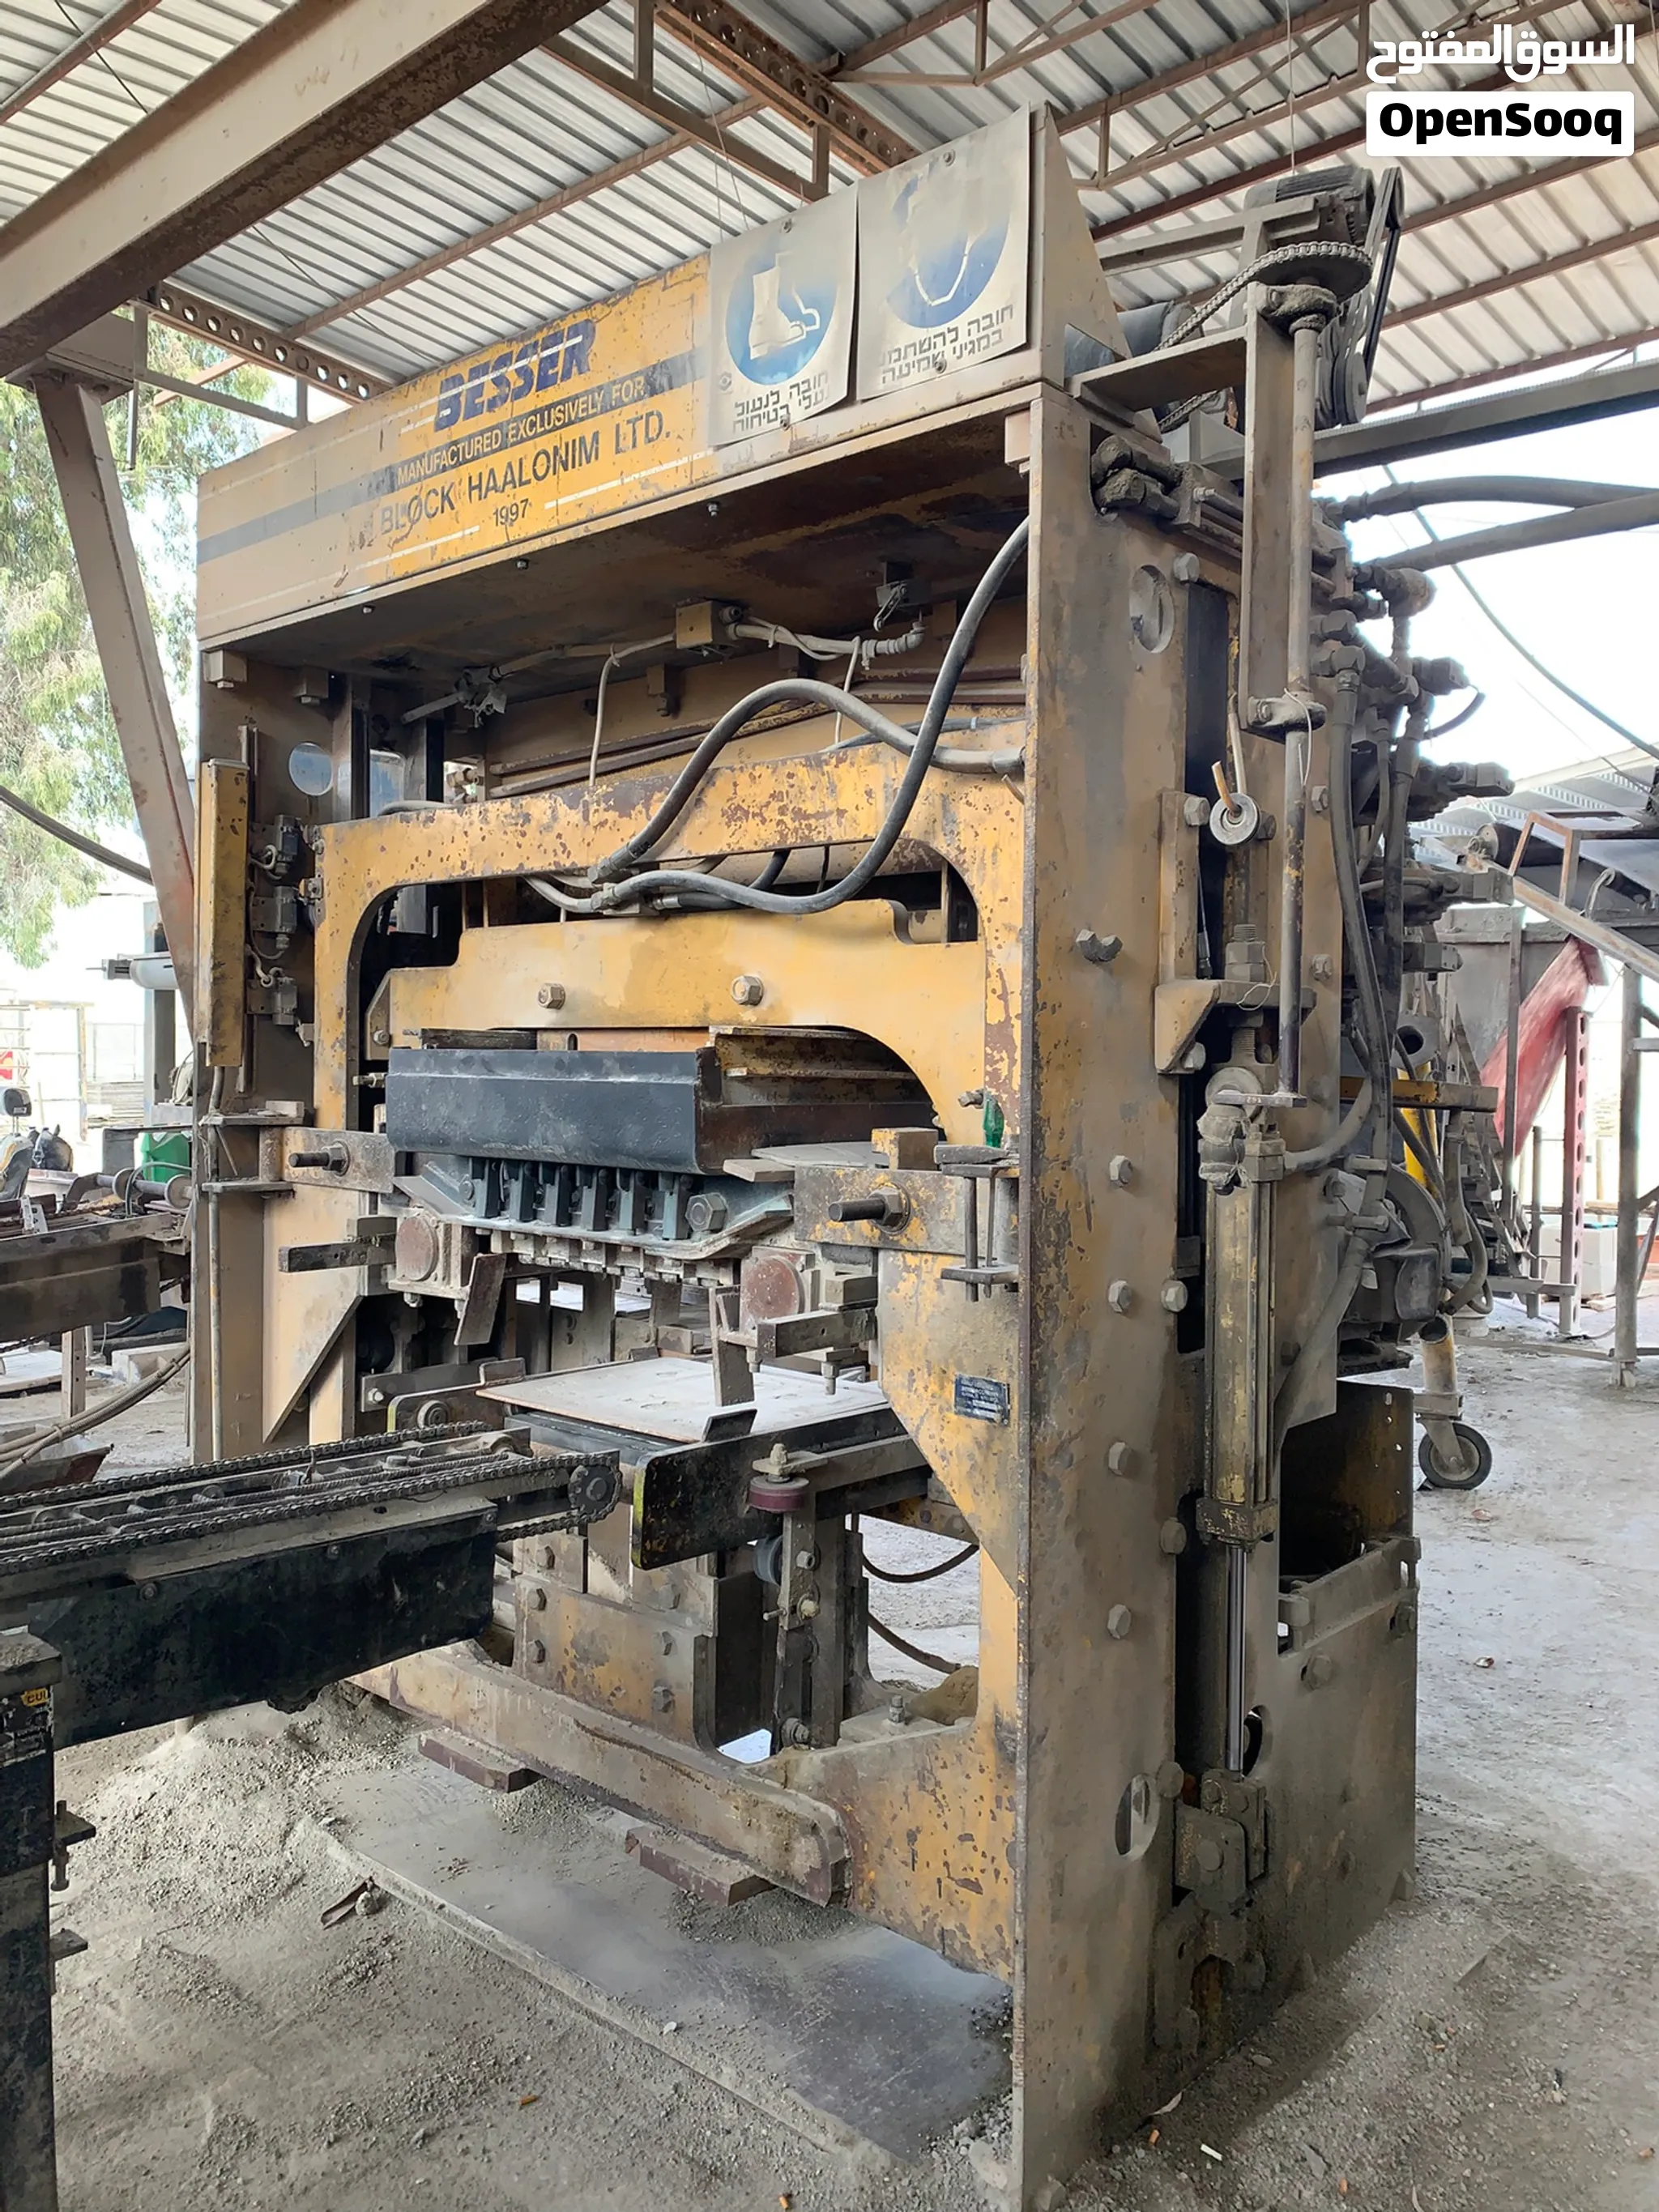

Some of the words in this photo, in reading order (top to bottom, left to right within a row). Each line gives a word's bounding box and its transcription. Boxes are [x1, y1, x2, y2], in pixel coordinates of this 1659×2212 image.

[967, 304, 1013, 337] חובה
[434, 319, 595, 432] BESSER
[789, 372, 829, 399] חובה
[734, 390, 780, 417] לנעול
[397, 428, 501, 486] MANUFACTURED
[507, 392, 604, 443] EXCLUSIVELY
[612, 374, 647, 410] FOR
[381, 483, 455, 535] BLOCK
[467, 431, 599, 503] HAALONIM
[614, 410, 672, 455] LTD.
[493, 498, 529, 528] 1997
